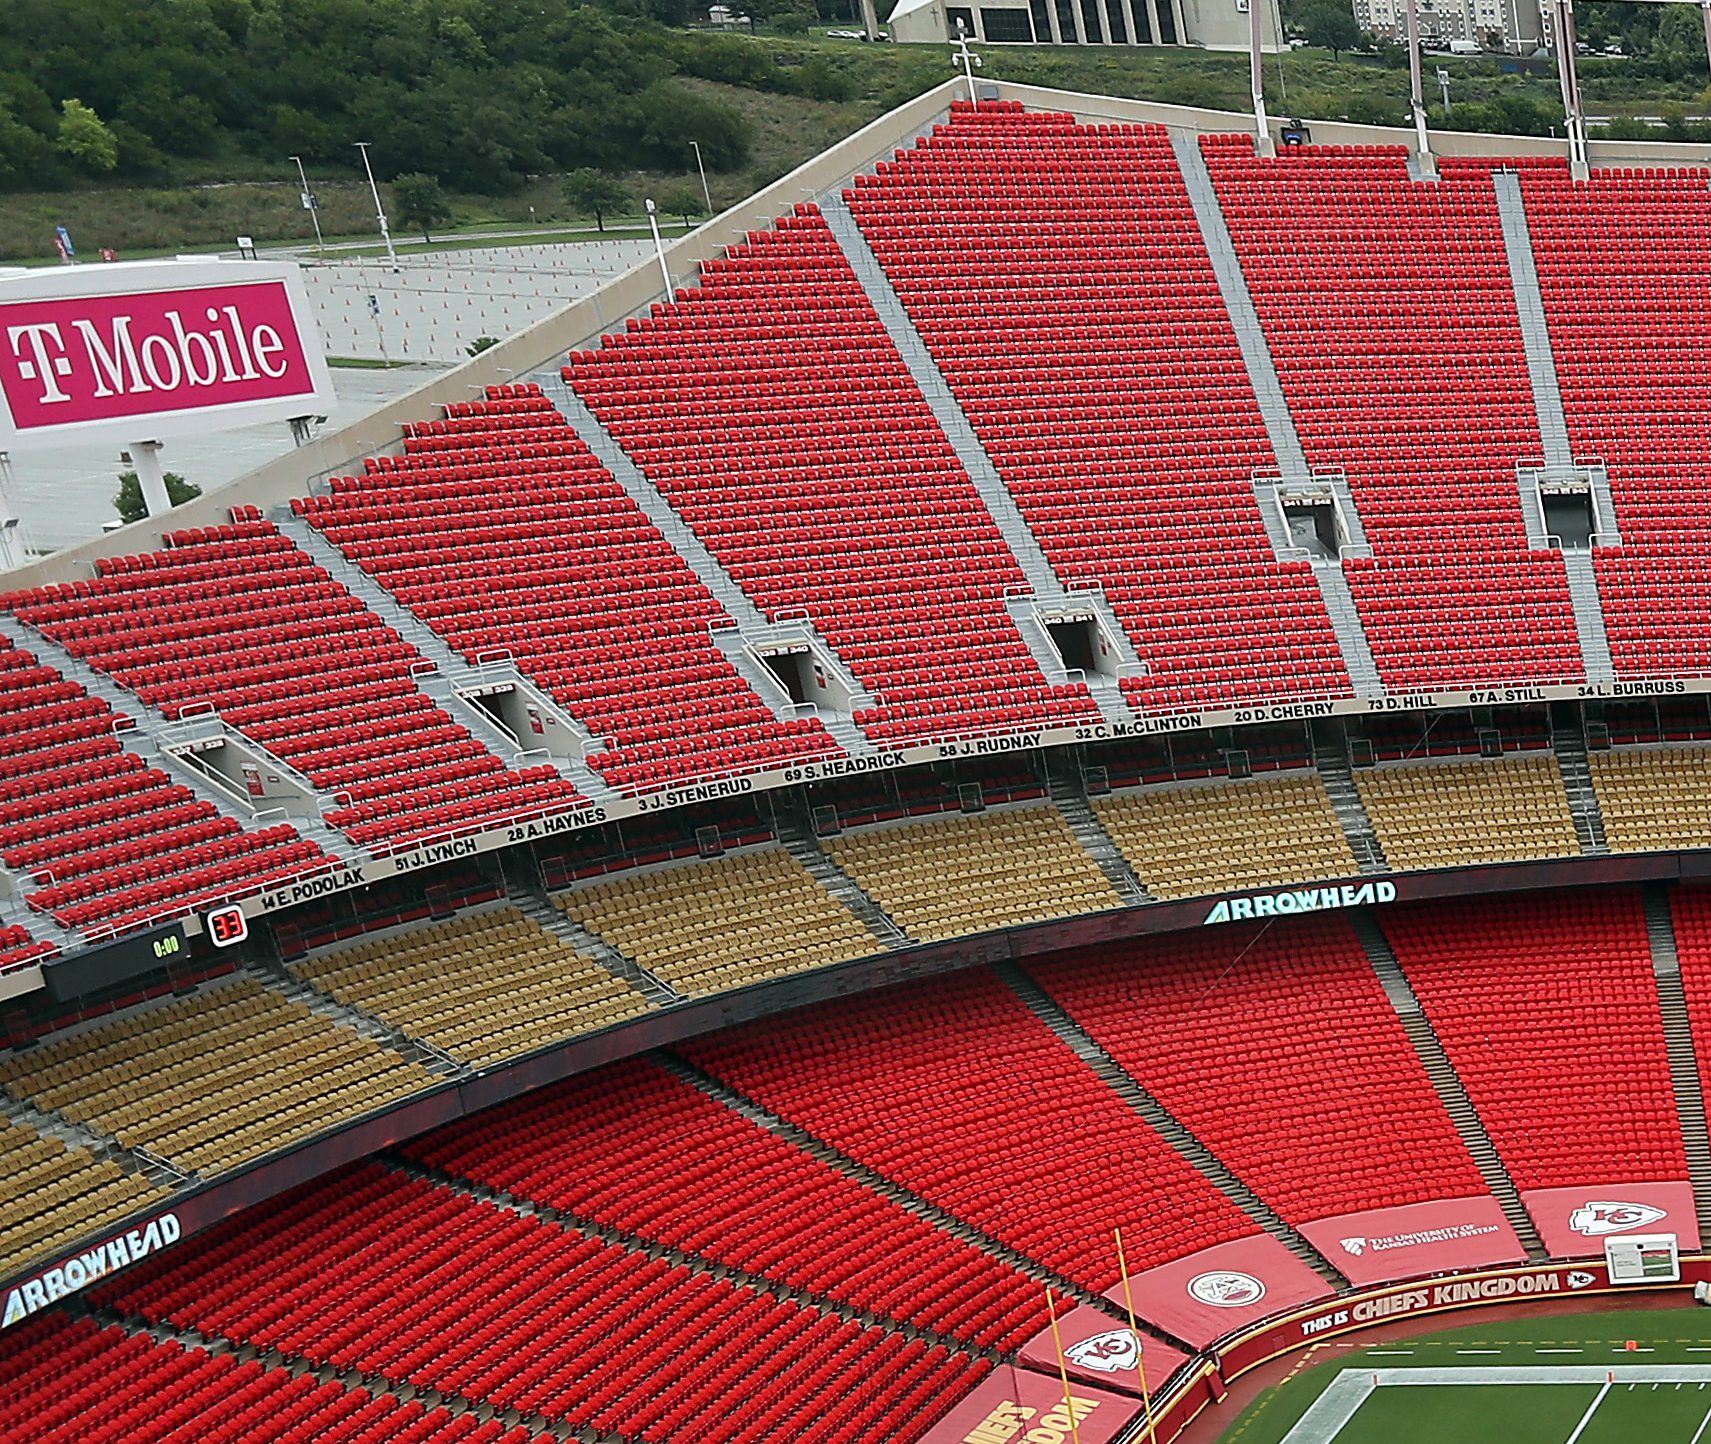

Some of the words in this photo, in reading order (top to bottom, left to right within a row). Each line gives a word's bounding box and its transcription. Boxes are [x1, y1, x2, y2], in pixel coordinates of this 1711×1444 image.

[75, 304, 290, 398] Mobile
[1578, 686, 1594, 696] 34
[1597, 685, 1610, 696] L.
[1613, 681, 1685, 695] BURRUSS
[1235, 711, 1251, 722] 20
[1255, 709, 1269, 720] D.
[1271, 703, 1333, 719] CHERRY
[785, 769, 801, 781] 69
[805, 766, 820, 779] S.
[822, 752, 906, 776] HEADRICK
[639, 800, 647, 810] 3
[651, 795, 664, 809] J.
[666, 779, 751, 805] STENERUD
[395, 857, 409, 870] 51
[411, 853, 425, 867] J.
[425, 838, 477, 863] LYNCH
[261, 896, 275, 910] 14
[276, 891, 291, 906] E.
[292, 868, 365, 901] PODOLAK
[1203, 880, 1397, 924] ARROWHEAD
[213, 917, 244, 941] 33
[152, 935, 179, 959] 0:00
[1, 1212, 181, 1328] ARROWHEAD
[1301, 1315, 1335, 1336] THIS
[1334, 1310, 1349, 1327] IS
[1352, 1288, 1430, 1322] CHIEFS
[1433, 1272, 1561, 1306] KINGDOM
